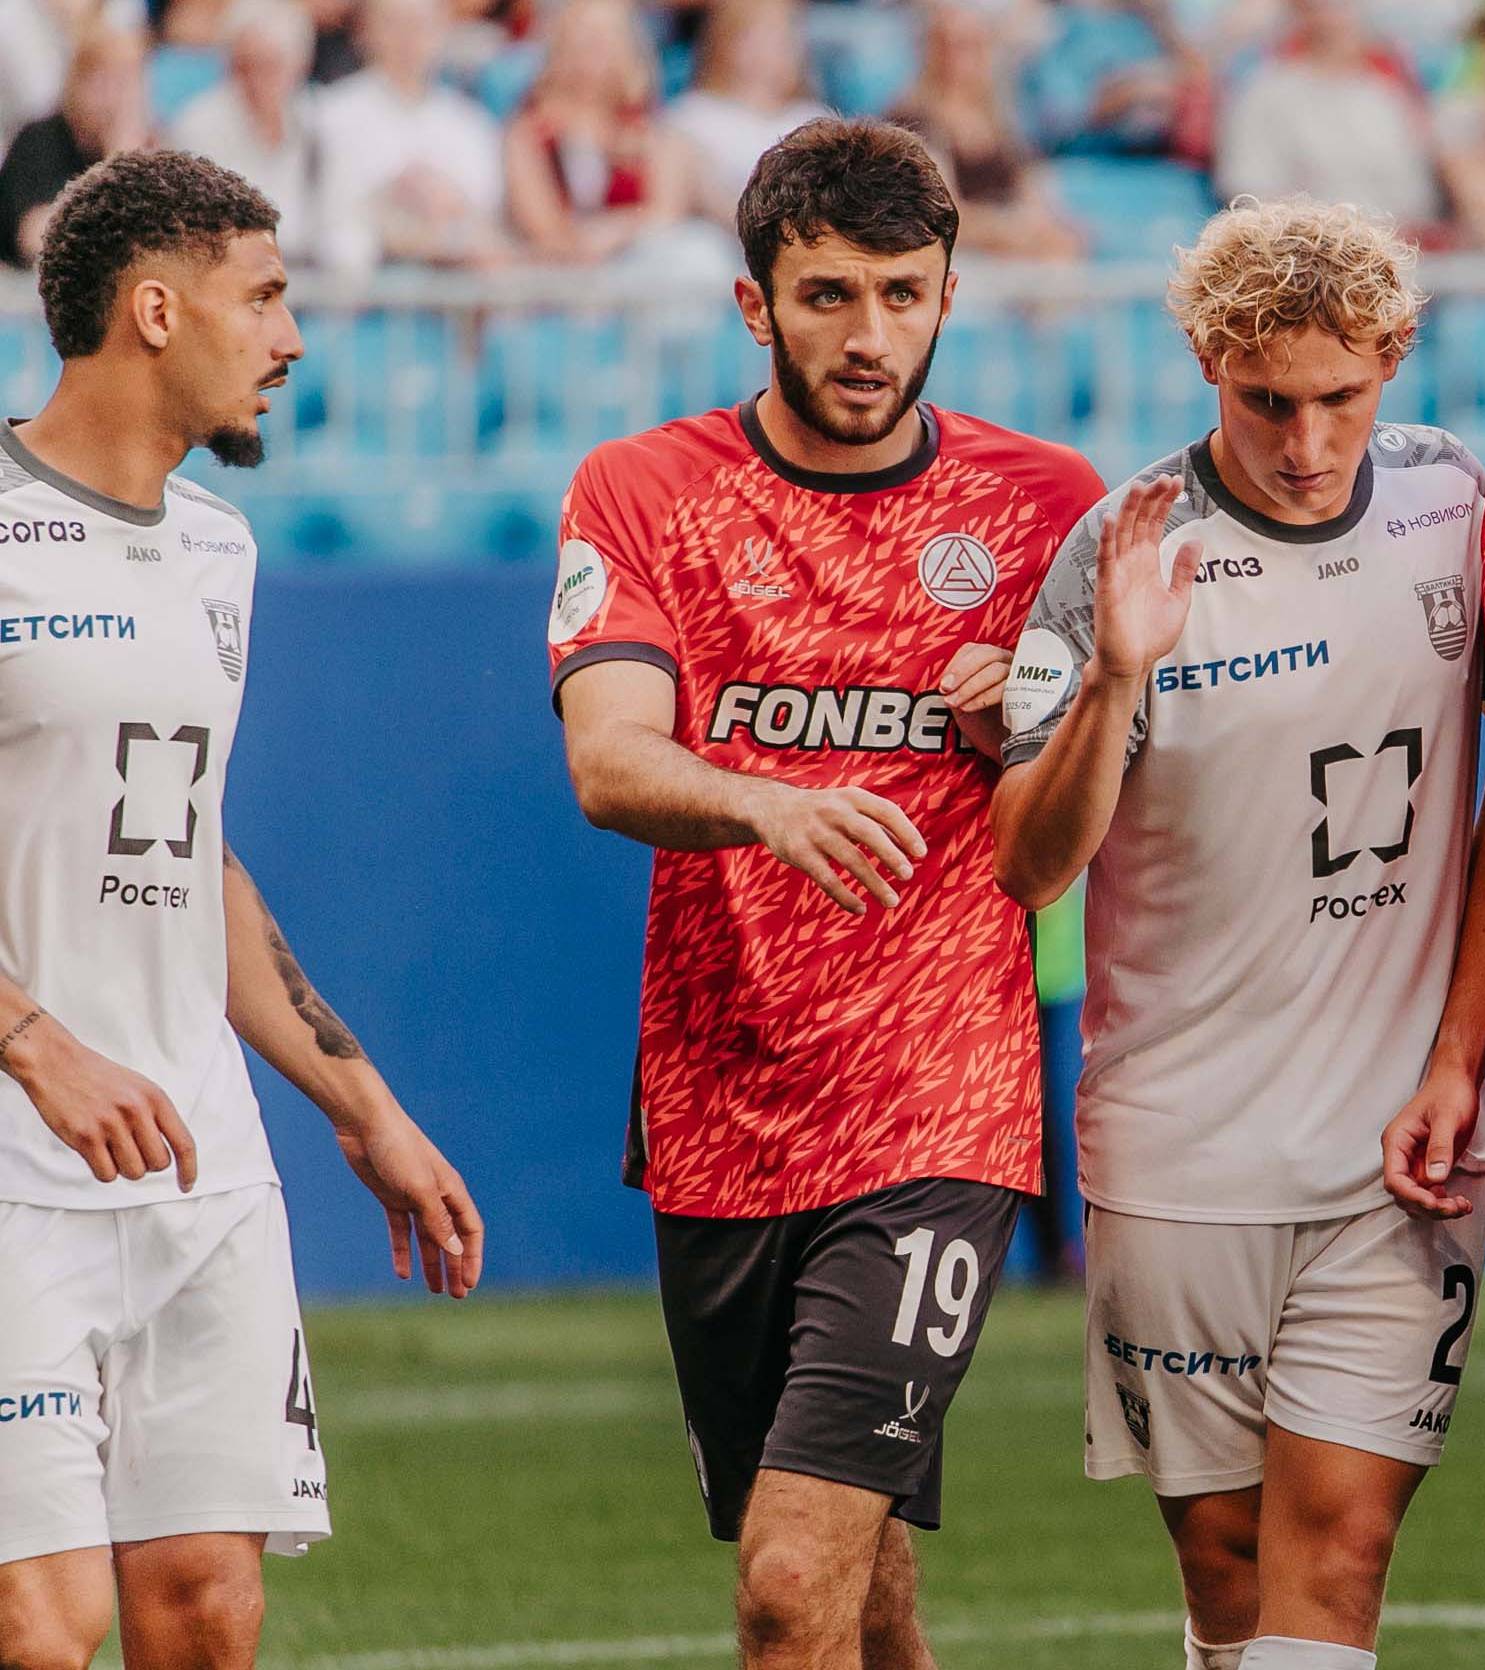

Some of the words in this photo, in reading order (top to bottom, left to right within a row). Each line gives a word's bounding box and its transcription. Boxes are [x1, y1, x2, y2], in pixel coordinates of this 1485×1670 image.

[126, 545, 162, 562] JAKO
[1317, 557, 1360, 580] JAKO
[0, 614, 135, 643] ЕТСИТИ
[1016, 665, 1063, 683] МИР
[1155, 639, 1330, 694] БЕТСИТИ
[706, 681, 978, 754] FONBE
[99, 875, 190, 909] Ростех
[891, 1226, 980, 1358] 19
[0, 1391, 82, 1423] СИТИ
[873, 1420, 922, 1443] JÖGEL
[292, 1478, 327, 1500] JAK
